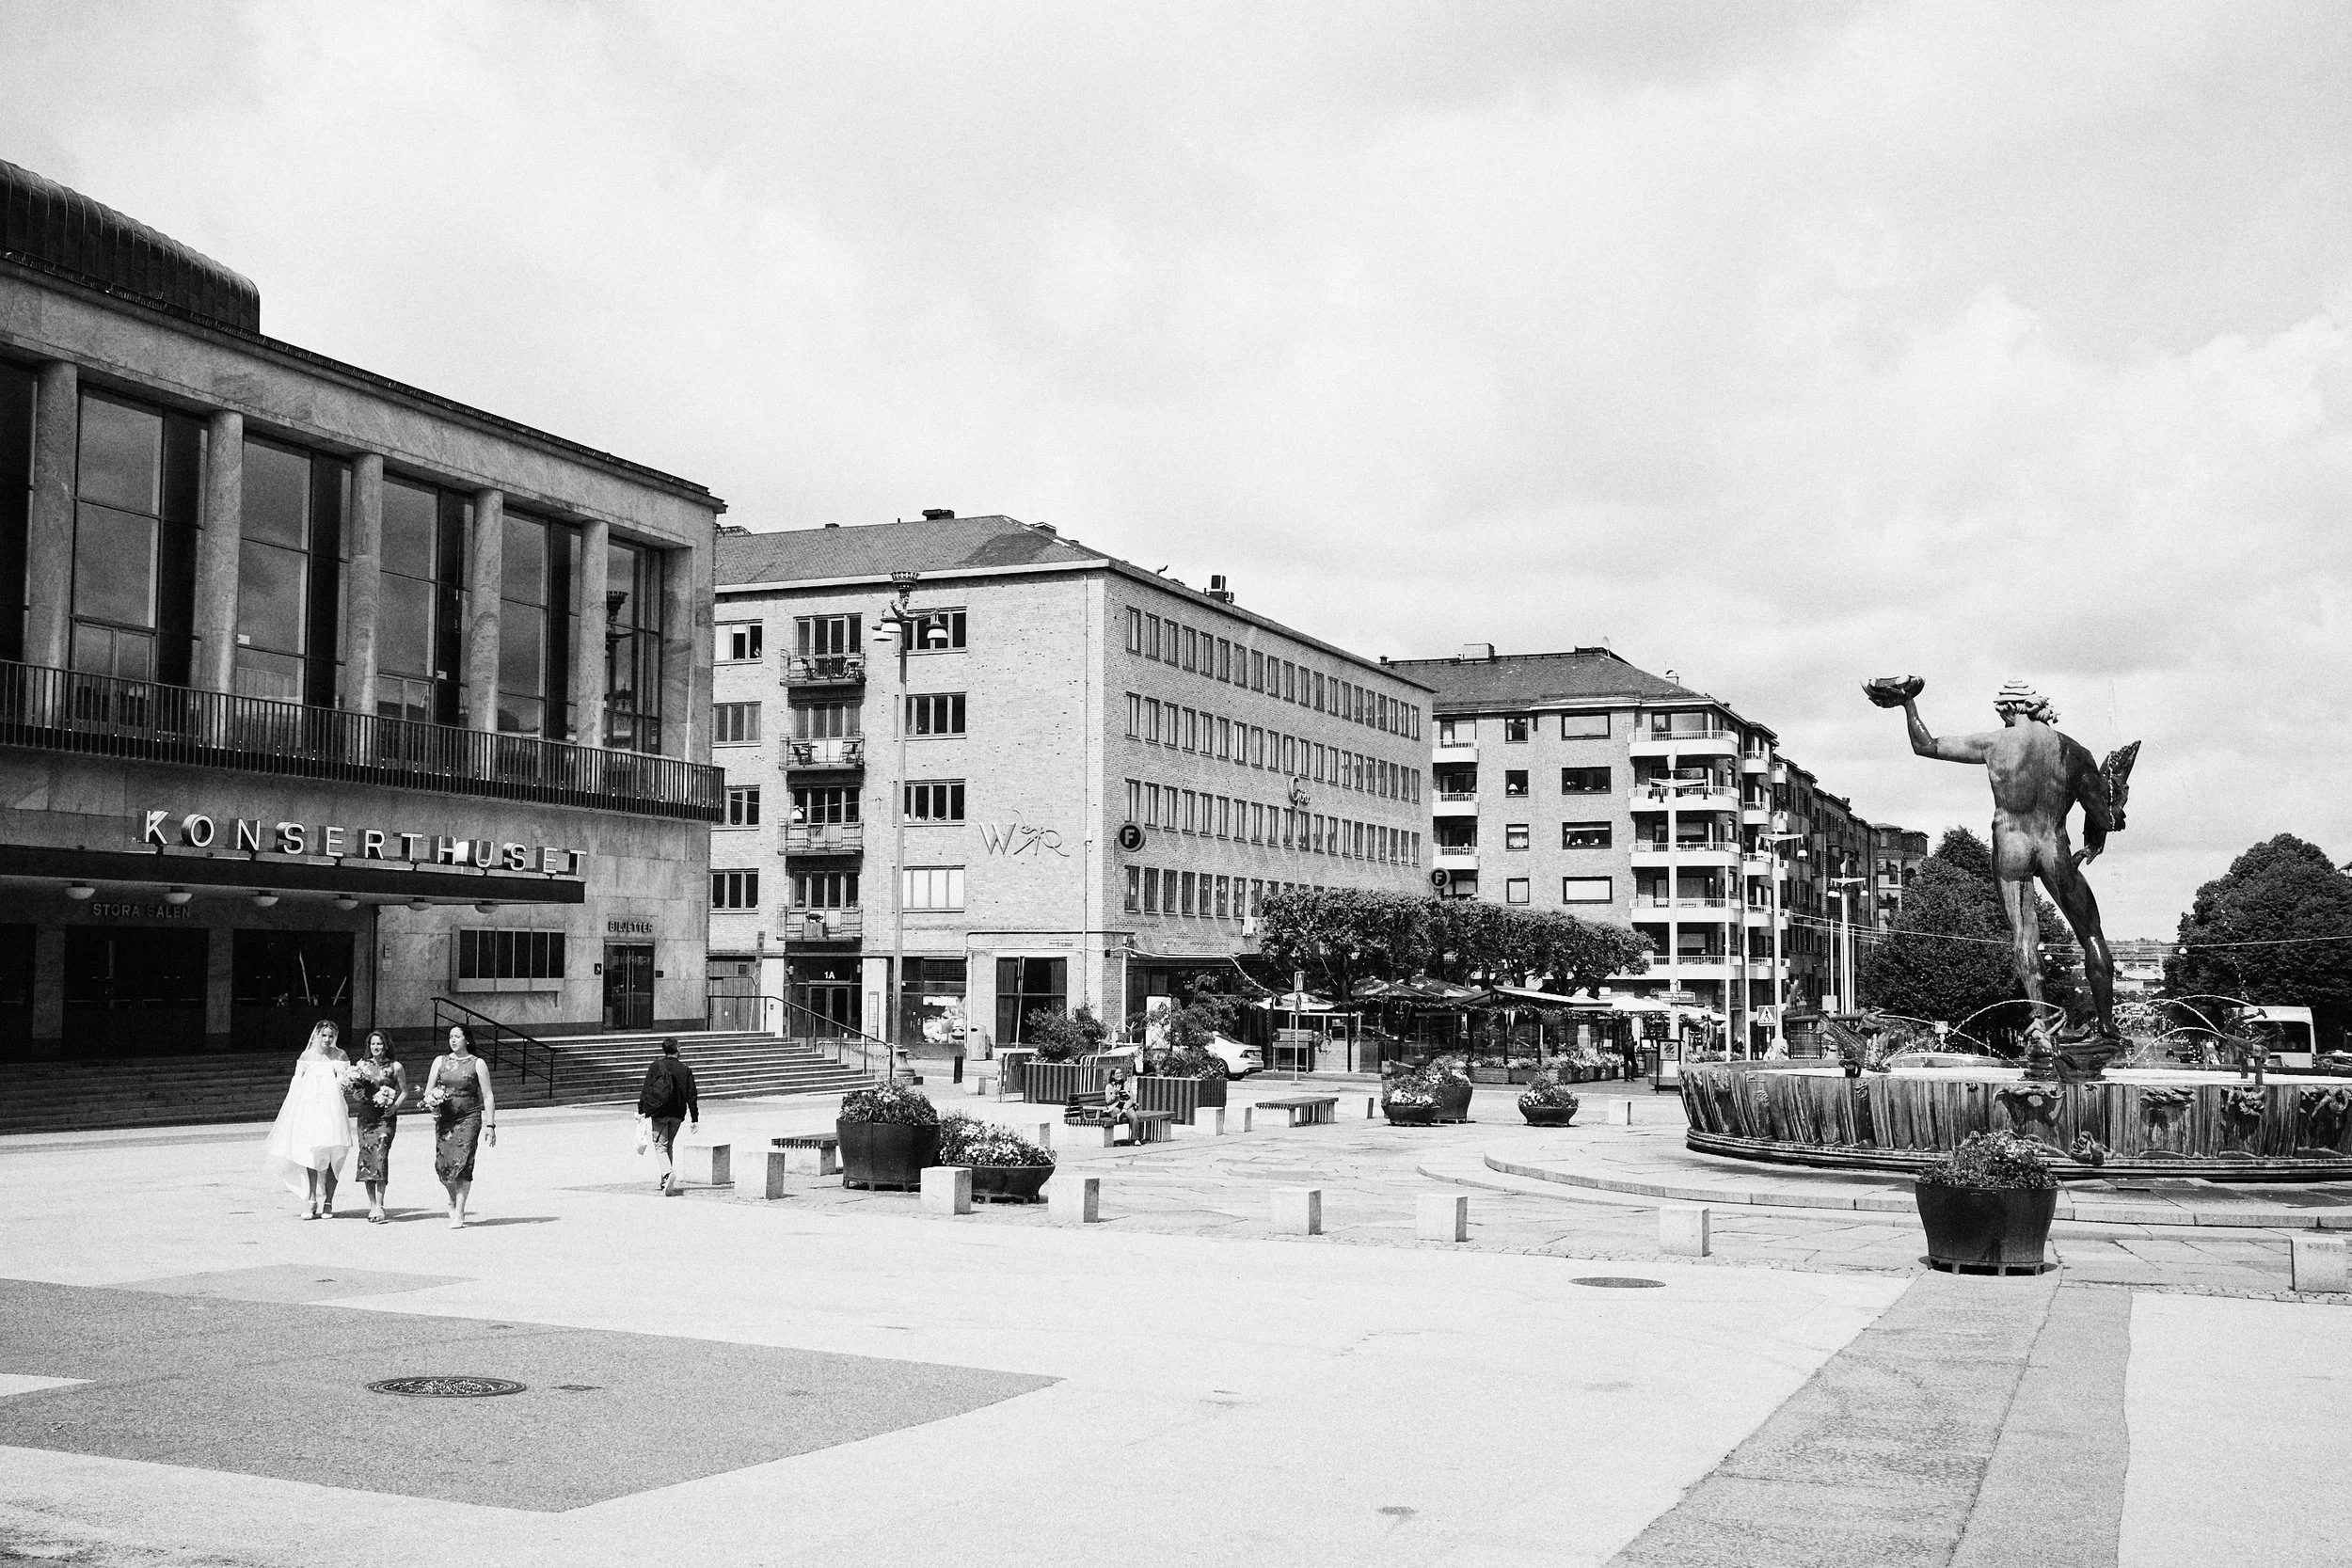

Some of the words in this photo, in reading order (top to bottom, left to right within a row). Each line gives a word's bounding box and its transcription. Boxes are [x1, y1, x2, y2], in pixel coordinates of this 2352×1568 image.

[145, 810, 587, 876] KONSERTHUSET
[1124, 829, 1136, 846] F
[1435, 872, 1443, 884] F
[92, 903, 140, 918] STORA
[608, 921, 653, 934] BILJETTER
[824, 971, 835, 980] 1A
